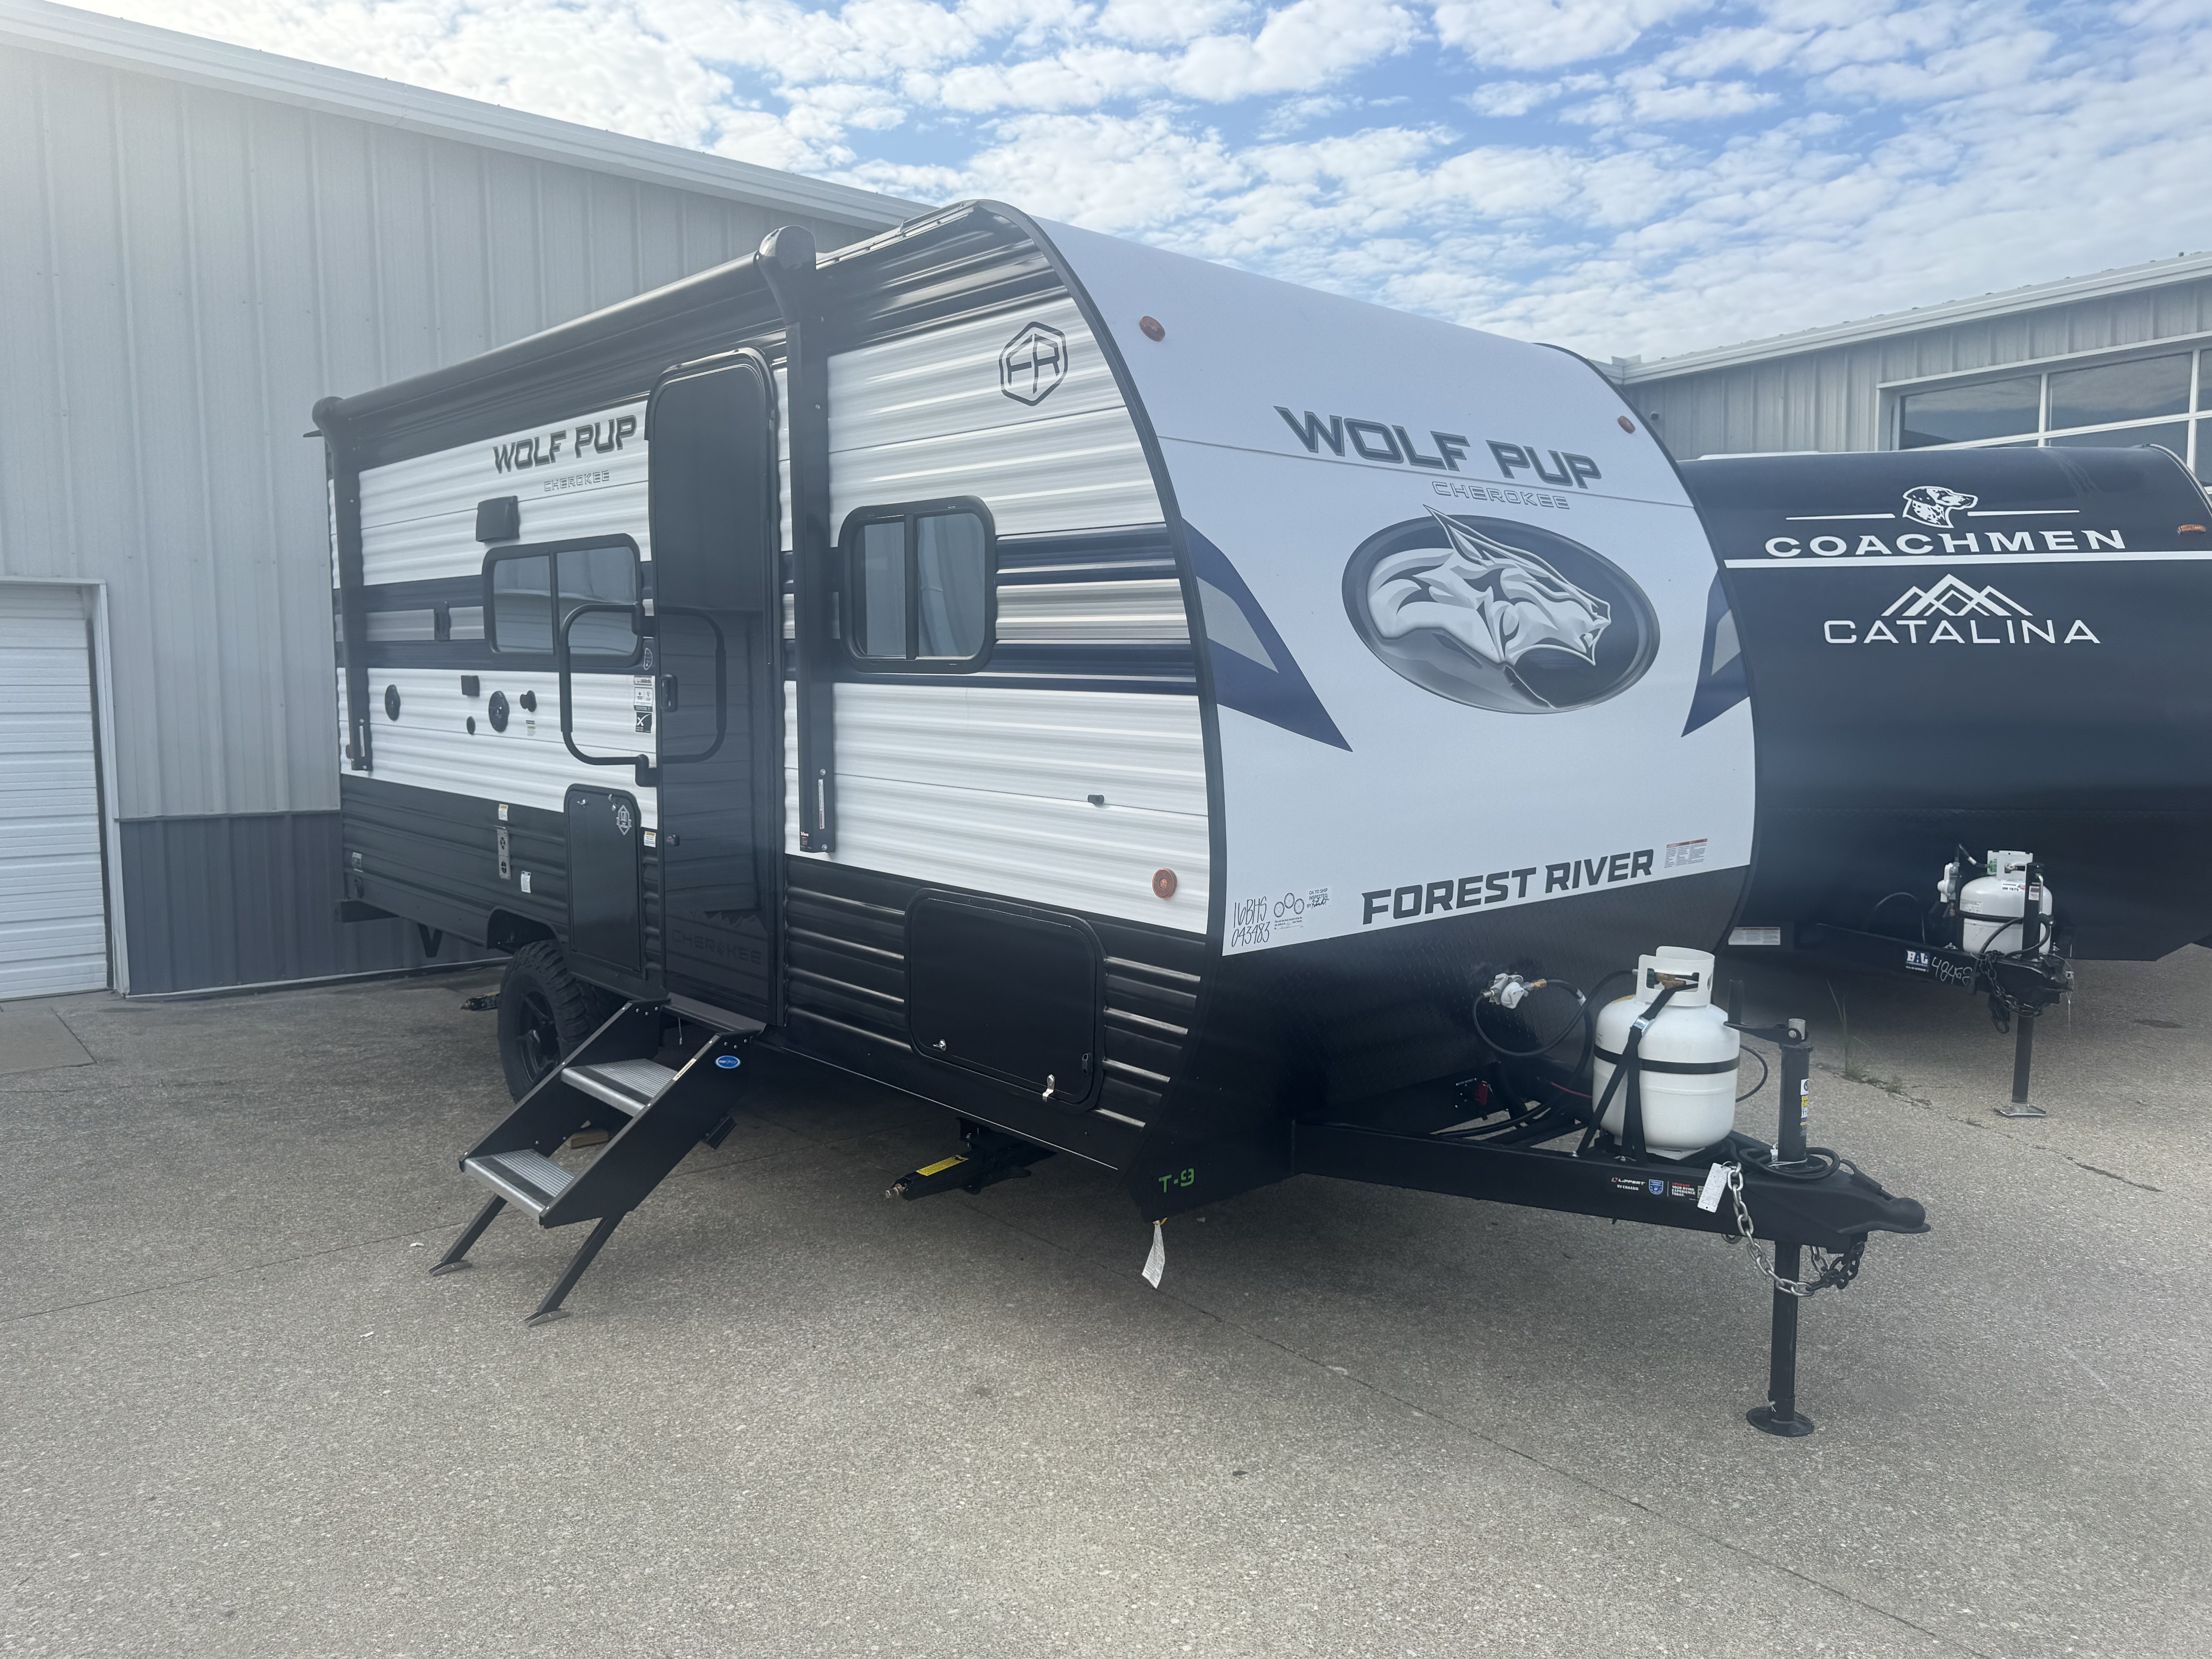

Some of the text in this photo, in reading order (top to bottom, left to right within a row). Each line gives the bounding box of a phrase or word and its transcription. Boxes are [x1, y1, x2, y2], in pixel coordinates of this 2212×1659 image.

[493, 415, 637, 474] WOLF PUP
[1273, 405, 1602, 489] WOLF PUP
[544, 470, 610, 491] CHEROKEE
[1431, 481, 1570, 510] CHEROKEE
[1765, 529, 2126, 557] COACHMEN
[1823, 619, 2100, 644] CATALINA
[1361, 867, 1537, 925] FOREST
[1545, 848, 1654, 894] RIVER
[1231, 921, 1271, 947] 043483
[1158, 1168, 1194, 1193] T-9
